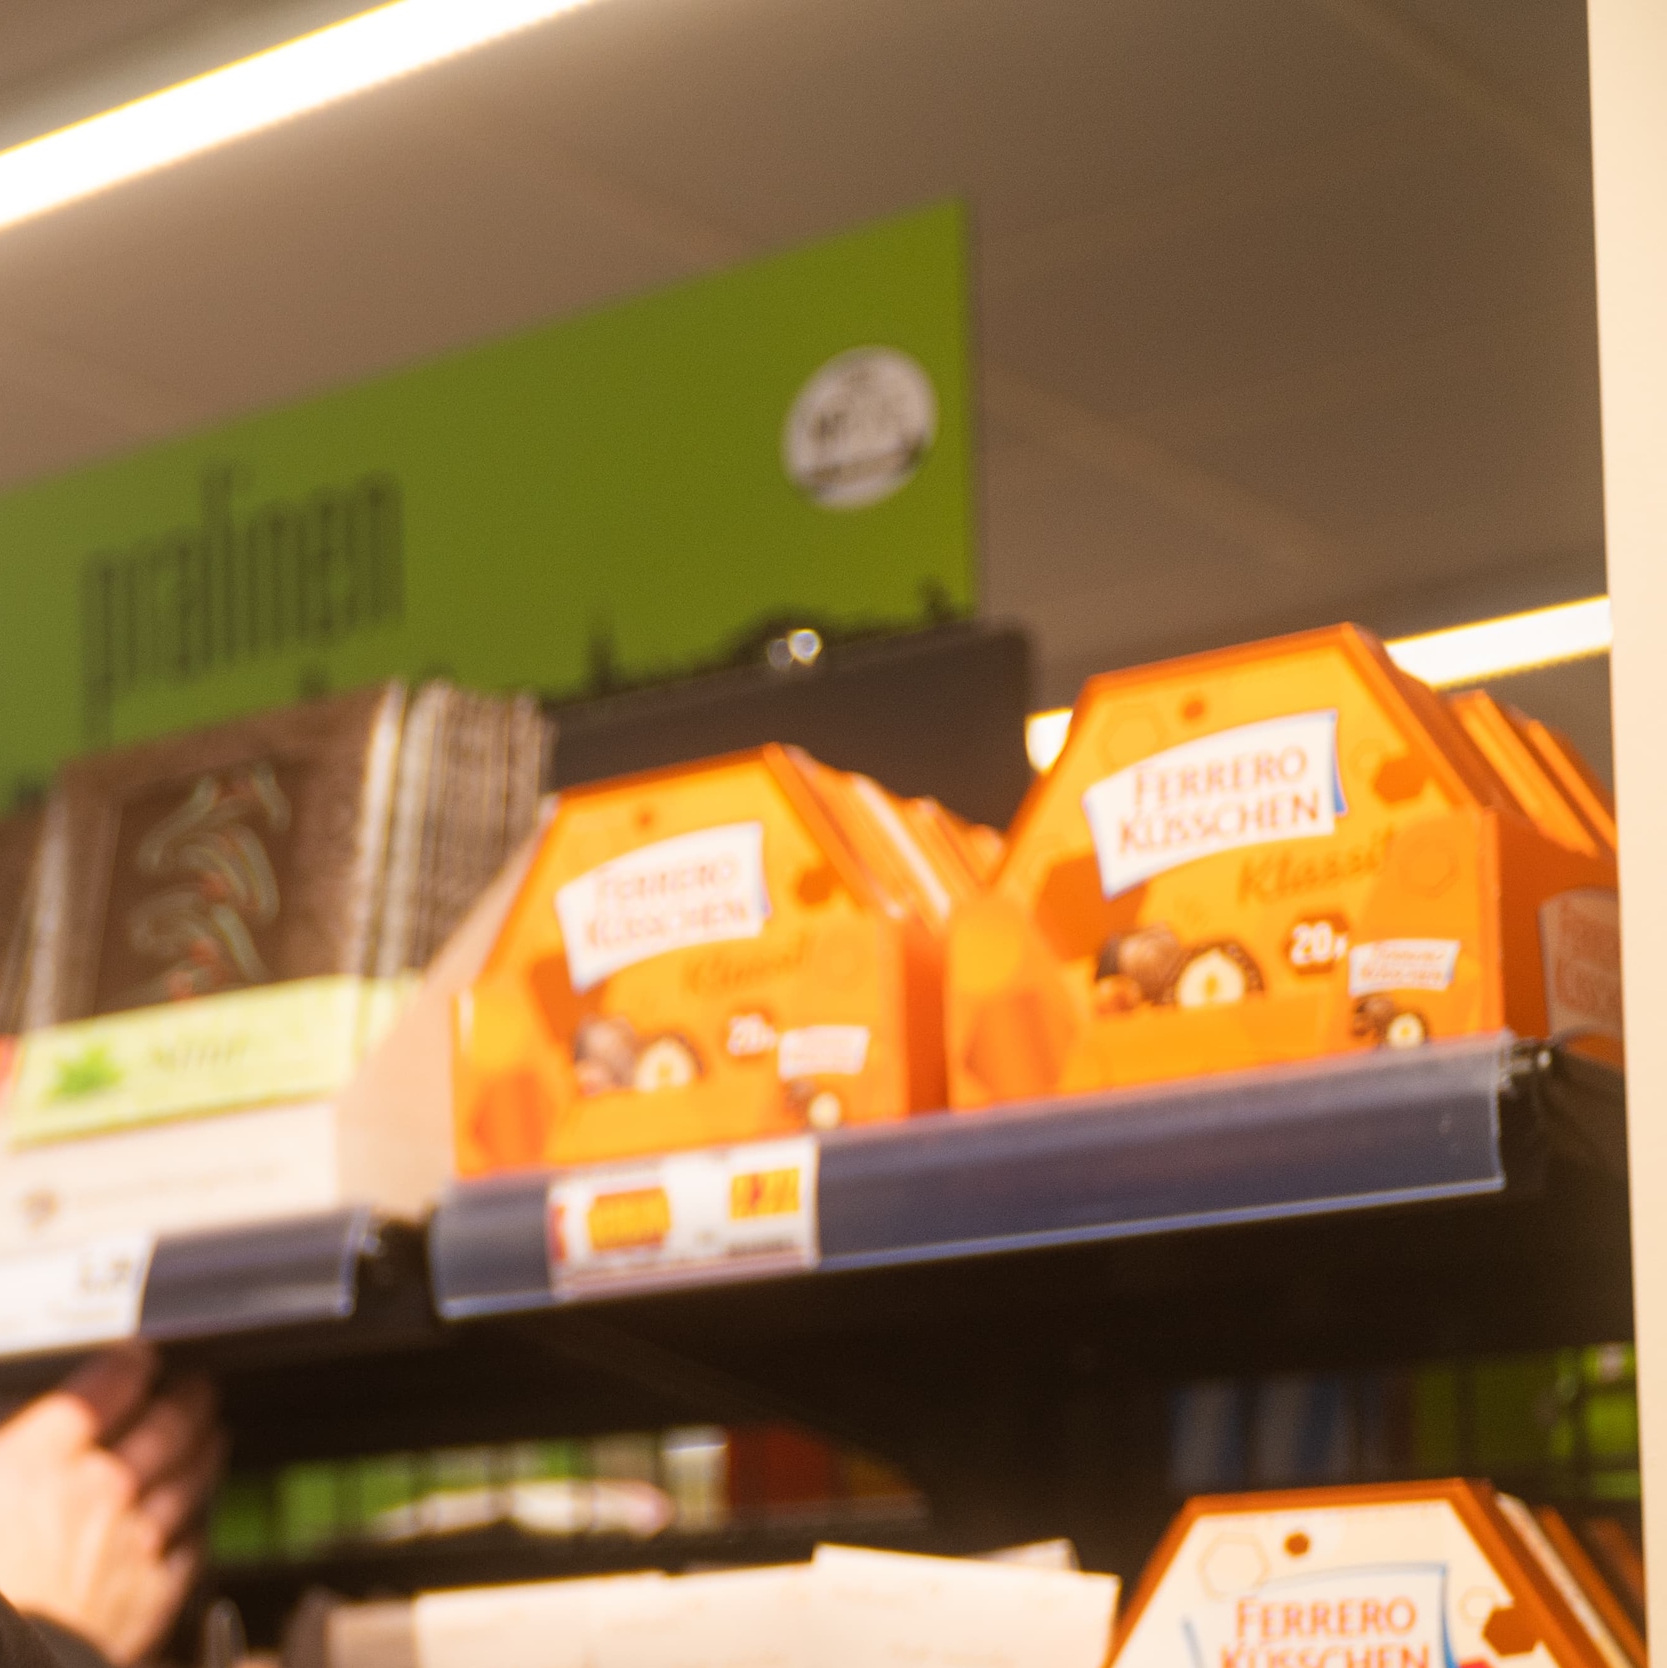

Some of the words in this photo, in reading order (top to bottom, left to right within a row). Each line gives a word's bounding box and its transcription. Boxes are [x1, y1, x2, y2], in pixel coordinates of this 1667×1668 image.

[80, 462, 405, 752] pralinen
[1134, 746, 1306, 804] FERRERO
[1235, 1596, 1416, 1640] FERRERO
